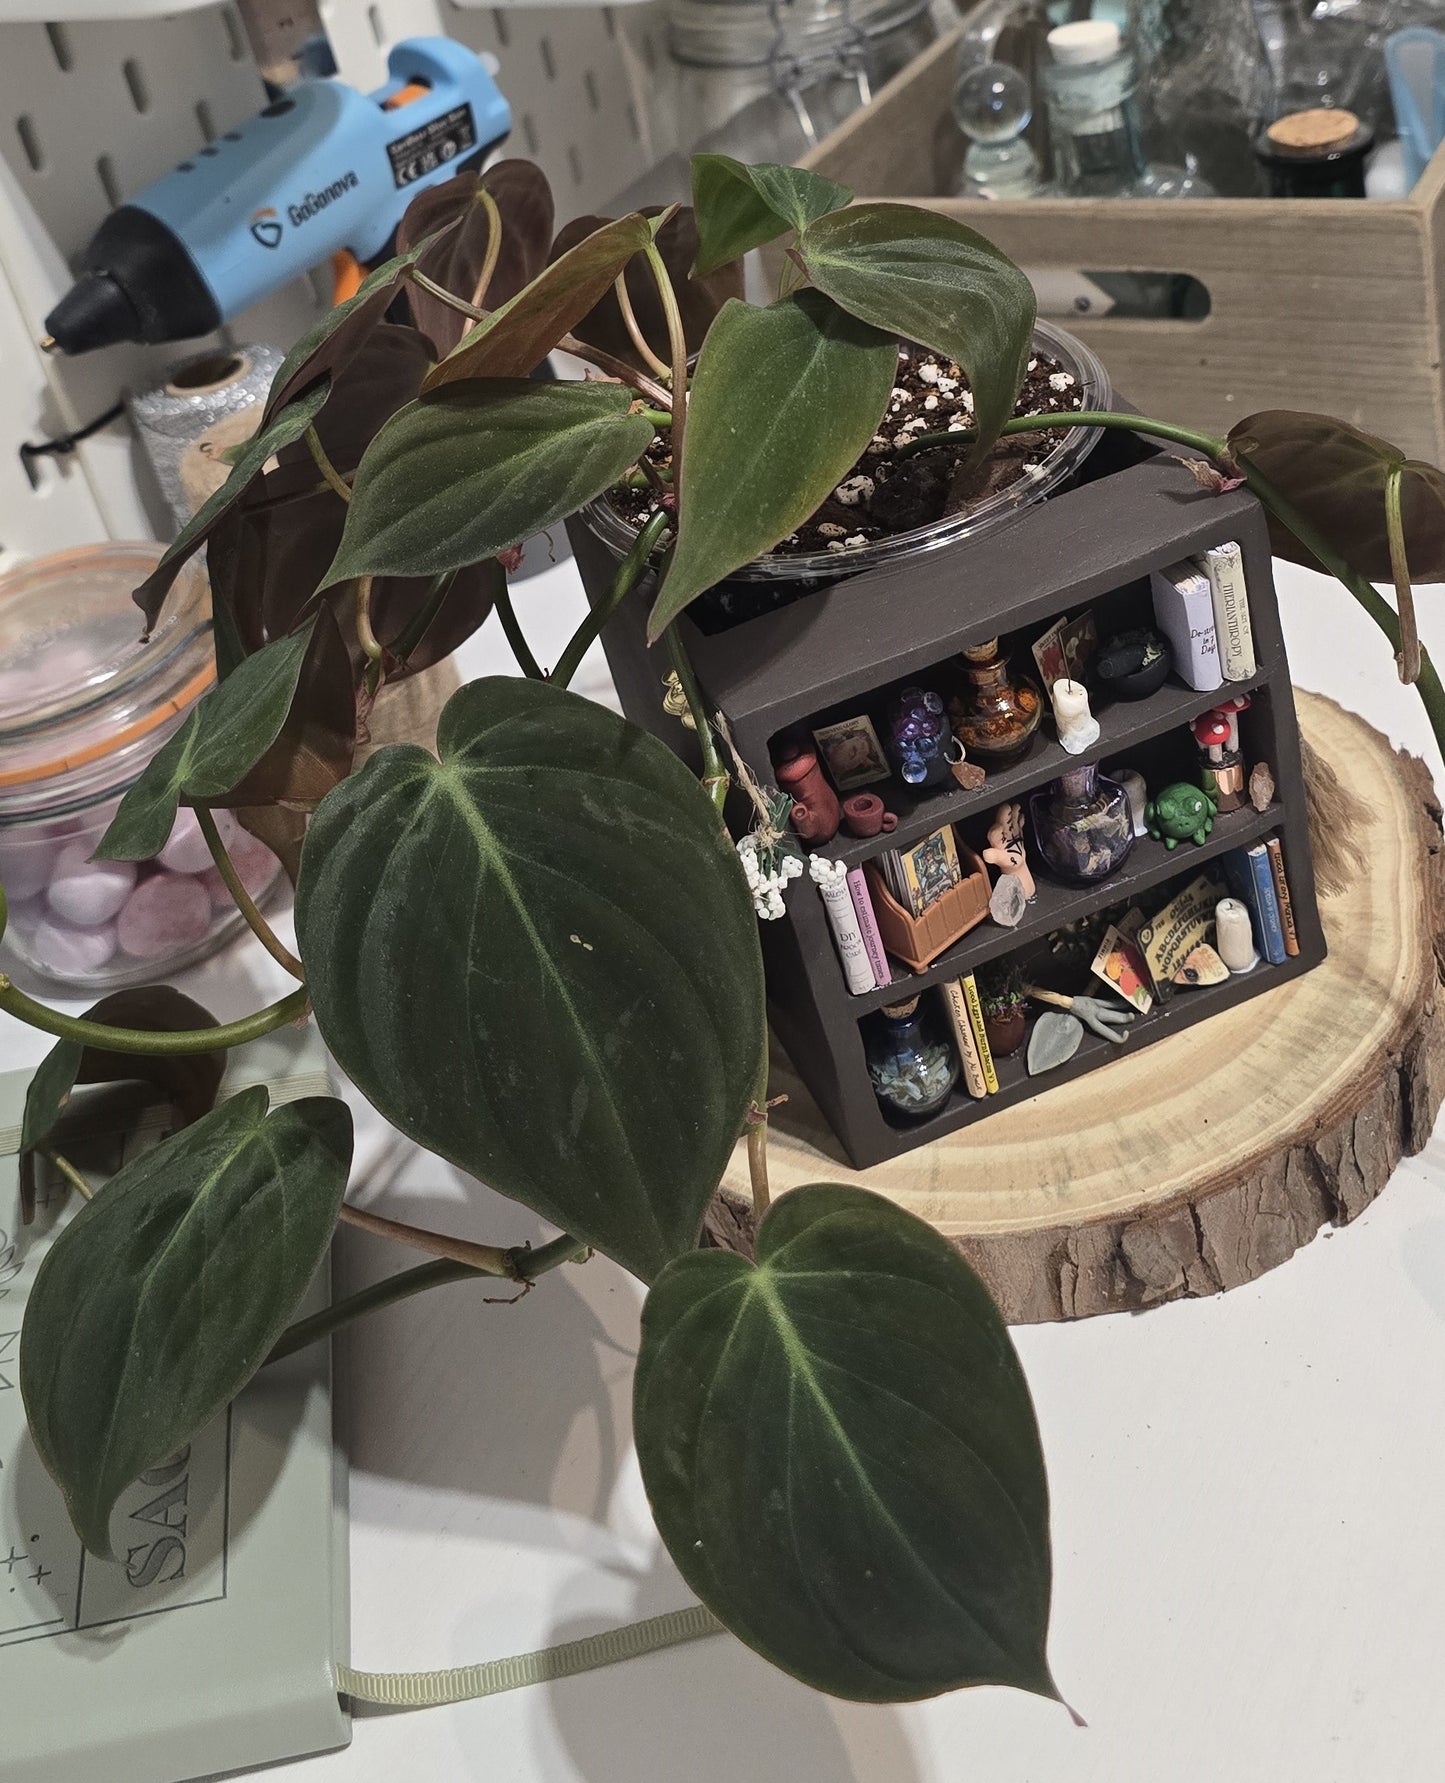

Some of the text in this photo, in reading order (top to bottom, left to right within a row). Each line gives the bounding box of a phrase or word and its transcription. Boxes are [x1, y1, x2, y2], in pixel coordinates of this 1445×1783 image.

[1222, 582, 1243, 658] THERIANTHROPY
[853, 880, 863, 897] How
[858, 896, 865, 905] to
[860, 906, 873, 935] estimate
[866, 934, 880, 962] journey
